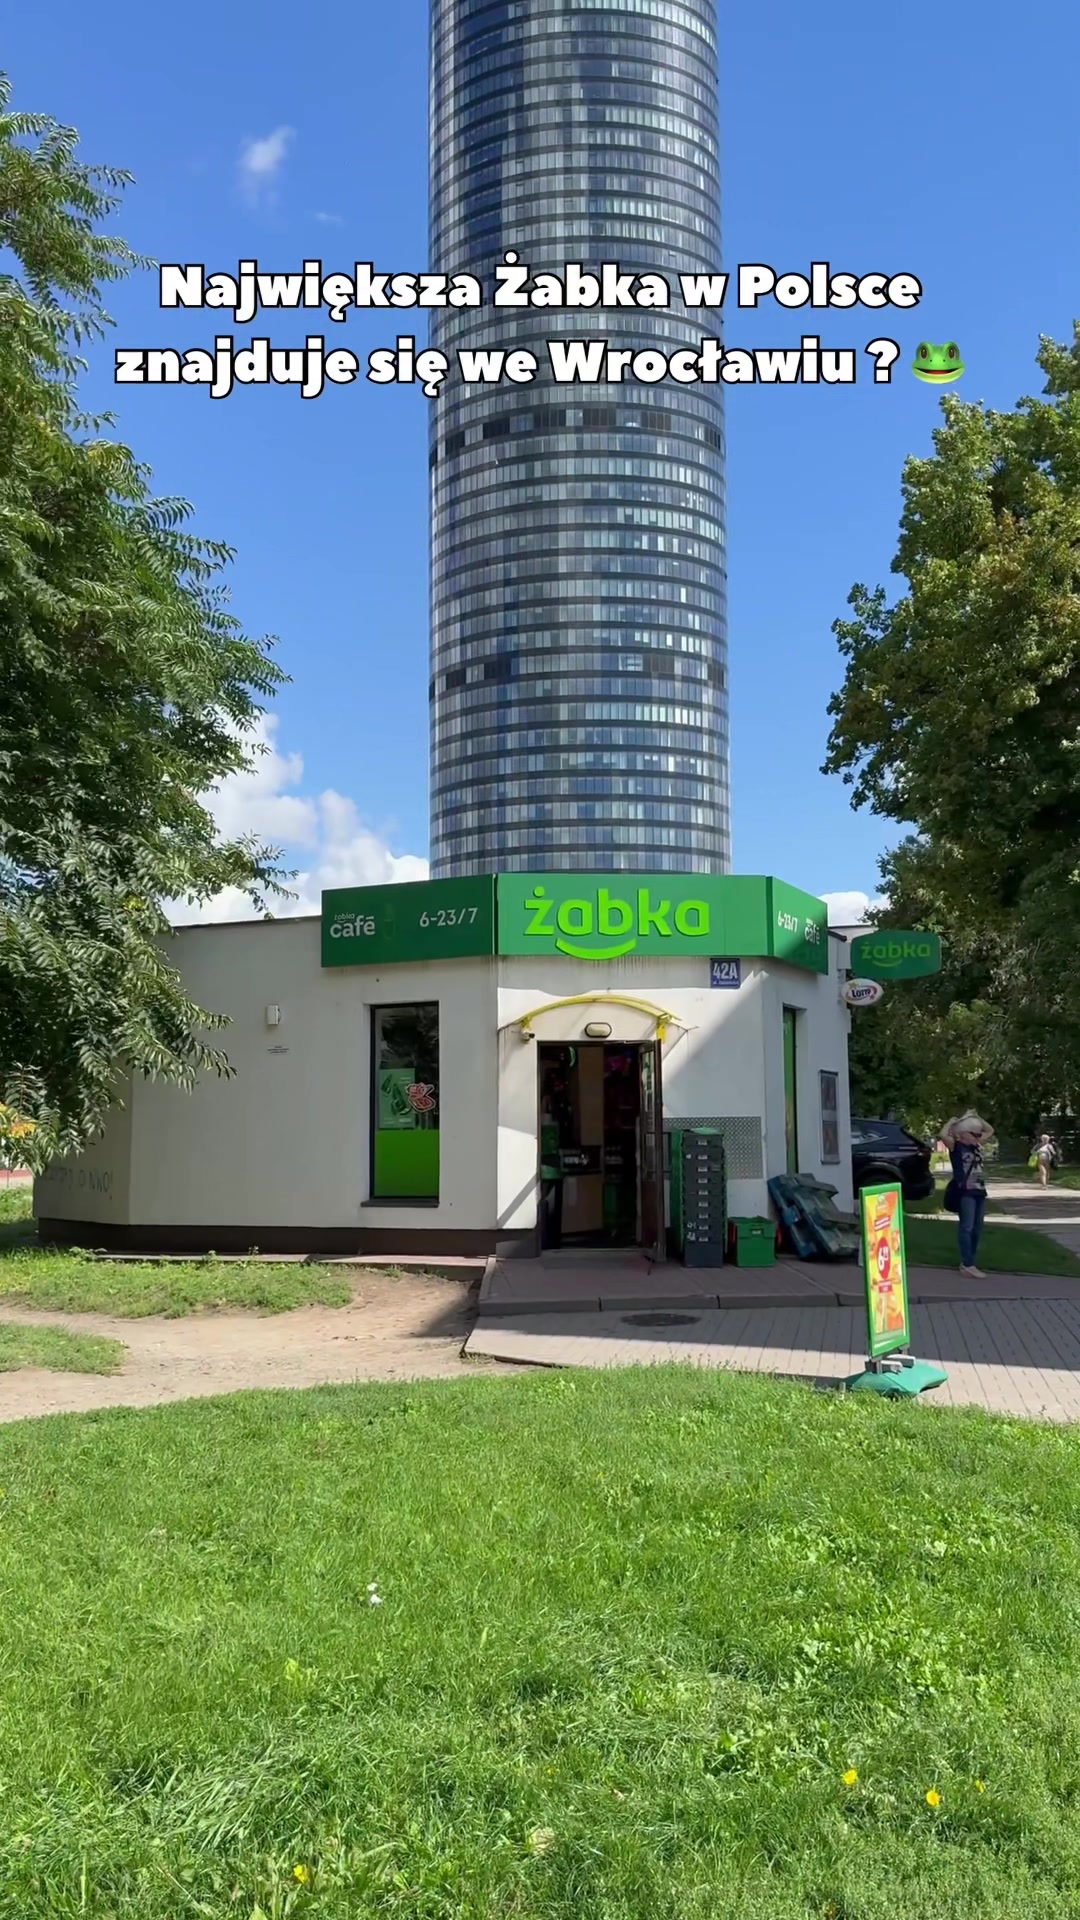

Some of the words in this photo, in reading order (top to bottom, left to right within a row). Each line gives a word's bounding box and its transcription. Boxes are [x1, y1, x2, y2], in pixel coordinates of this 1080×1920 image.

[419, 907, 478, 928] 6-23/7
[524, 886, 710, 937] żabka
[777, 910, 798, 933] 6-23/7
[861, 941, 931, 959] żabka
[713, 962, 738, 979] 42A
